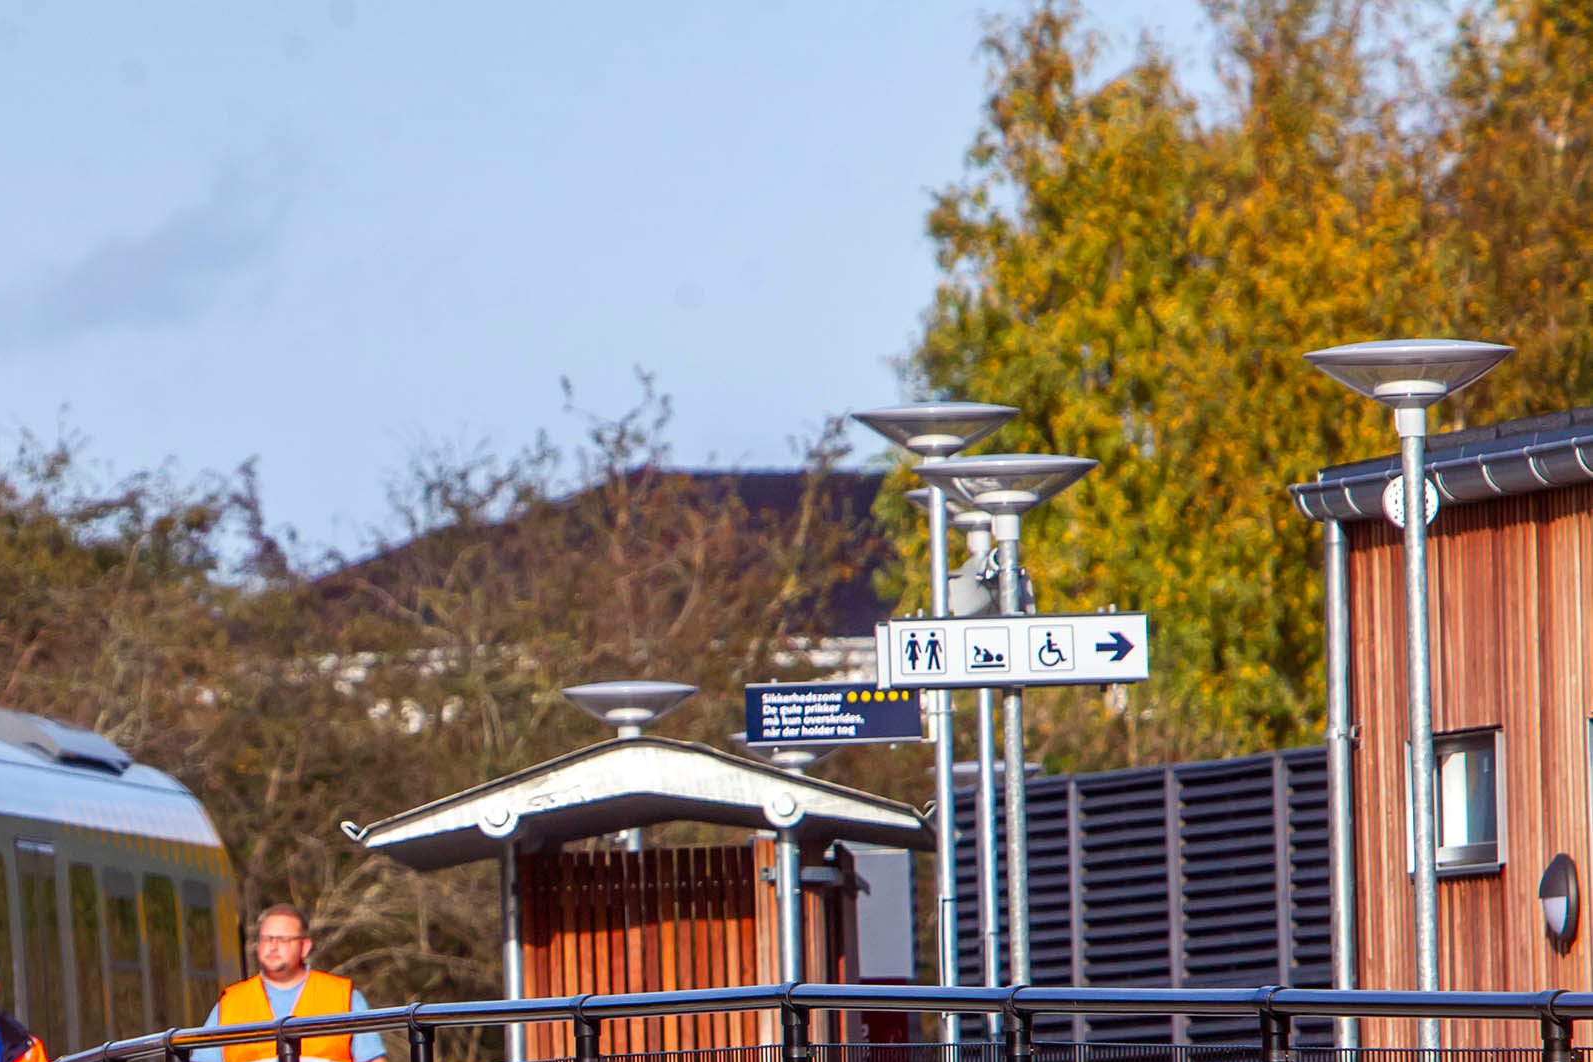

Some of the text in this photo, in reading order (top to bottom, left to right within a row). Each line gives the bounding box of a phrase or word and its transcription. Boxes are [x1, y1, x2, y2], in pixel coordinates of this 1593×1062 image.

[762, 692, 843, 704] Sikkerhedszone
[762, 702, 841, 716] De gule prikker
[762, 715, 780, 726] må
[781, 714, 802, 725] kun
[763, 725, 856, 737] når der holder tog
